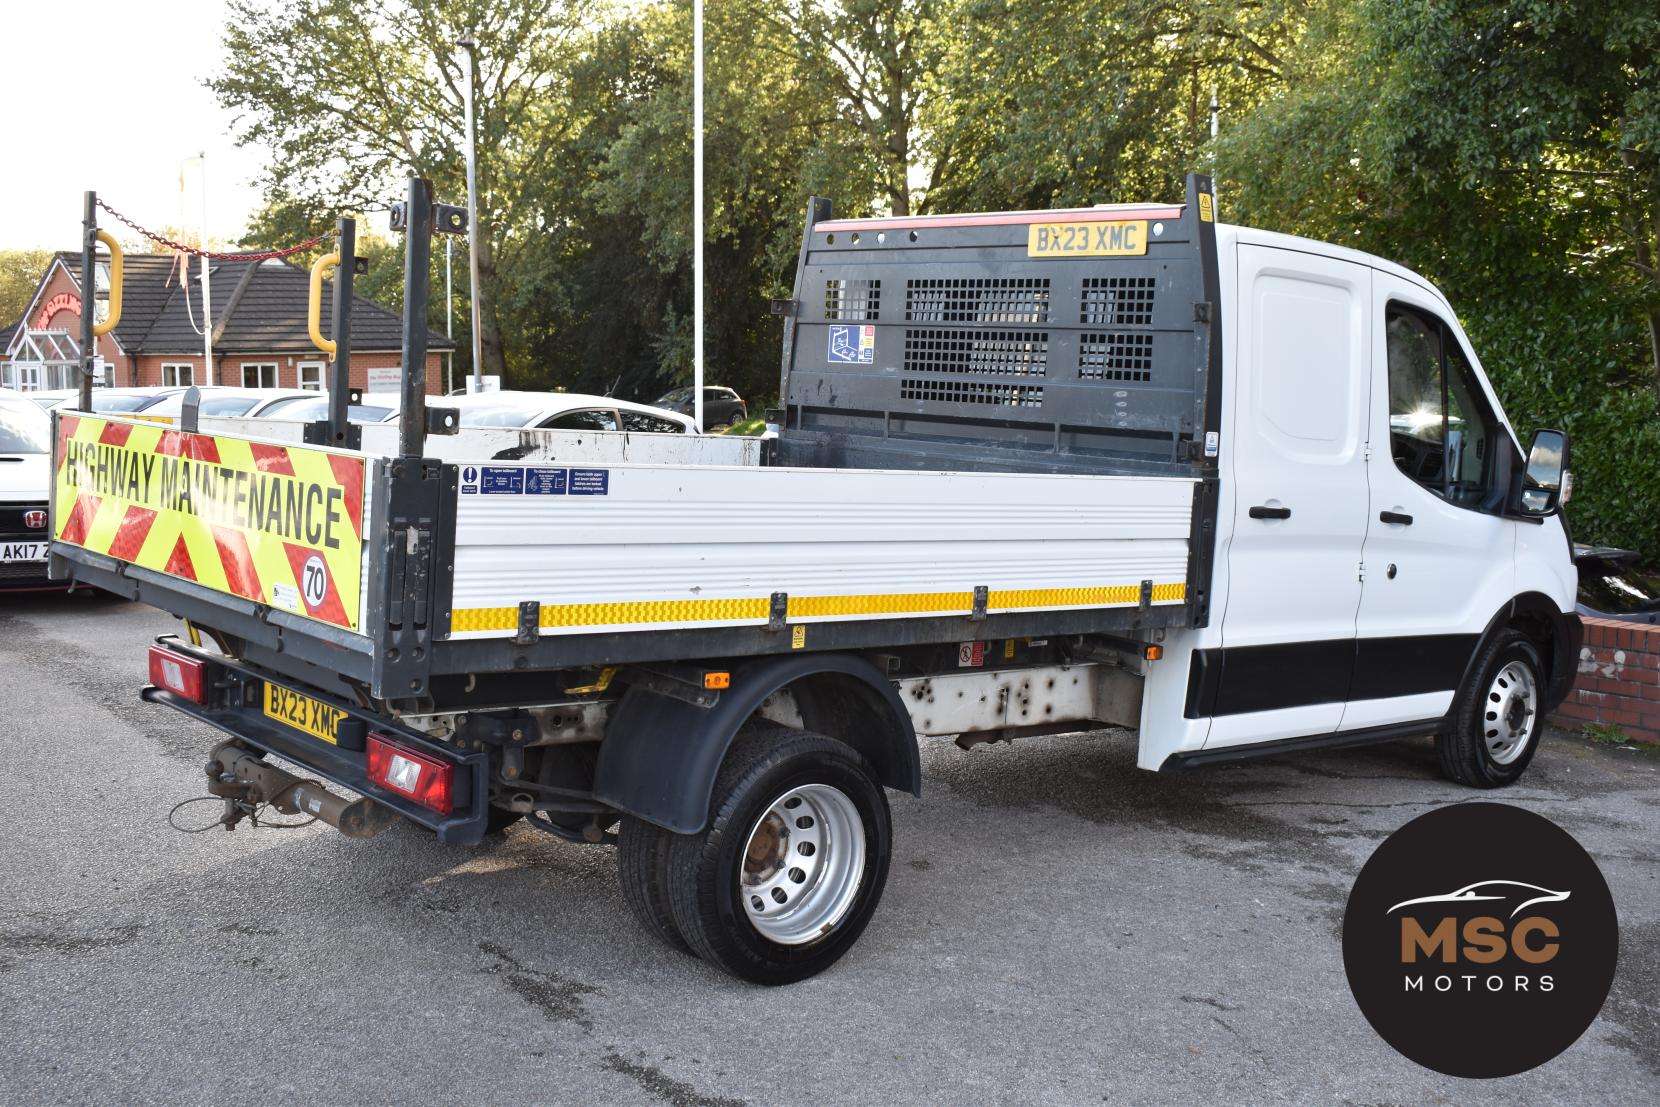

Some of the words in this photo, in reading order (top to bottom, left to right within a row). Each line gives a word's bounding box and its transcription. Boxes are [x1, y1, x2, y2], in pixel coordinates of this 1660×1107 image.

[1037, 226, 1090, 251] BX23
[1095, 224, 1137, 251] XMC
[66, 440, 155, 504] HIGHWAY
[160, 456, 342, 550] MAINTENANCE
[3, 544, 38, 559] AK17
[306, 565, 326, 601] 70
[270, 684, 307, 726] BX23
